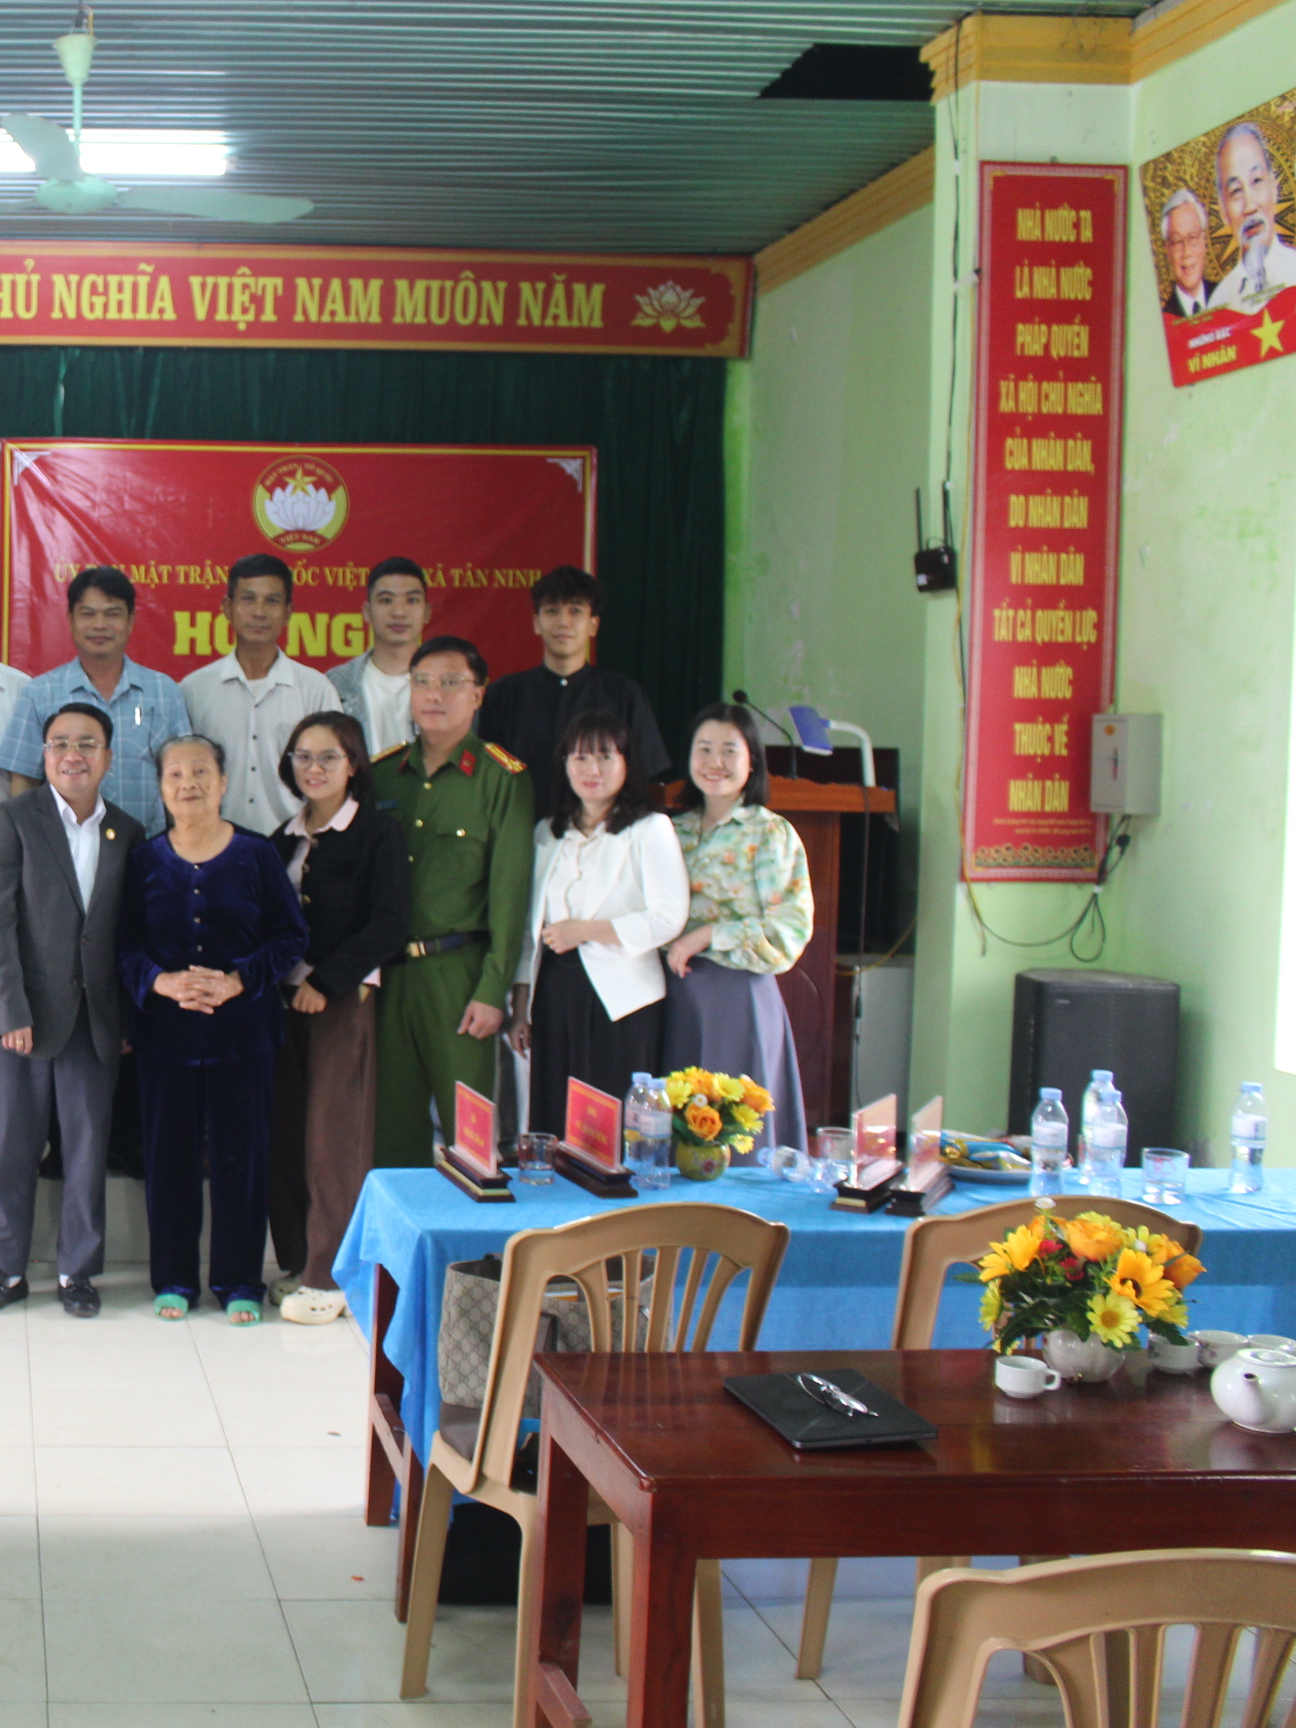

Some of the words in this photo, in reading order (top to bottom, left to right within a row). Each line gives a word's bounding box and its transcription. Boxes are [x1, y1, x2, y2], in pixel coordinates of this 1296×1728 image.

[1080, 210, 1092, 242] TA
[51, 264, 177, 319] NGHĨA
[189, 267, 283, 330] VIỆT
[293, 278, 383, 322] NAM
[393, 271, 507, 325] MUÔN
[517, 273, 605, 328] NĂM
[1016, 259, 1030, 298] LÀ
[131, 560, 172, 588] MẶT
[177, 560, 230, 589] TRẬN
[323, 562, 370, 591] VIỆT
[450, 563, 489, 588] TÂN
[493, 568, 542, 588] NINH
[1009, 773, 1042, 812] NHÂN
[1044, 773, 1069, 812] DÂN
